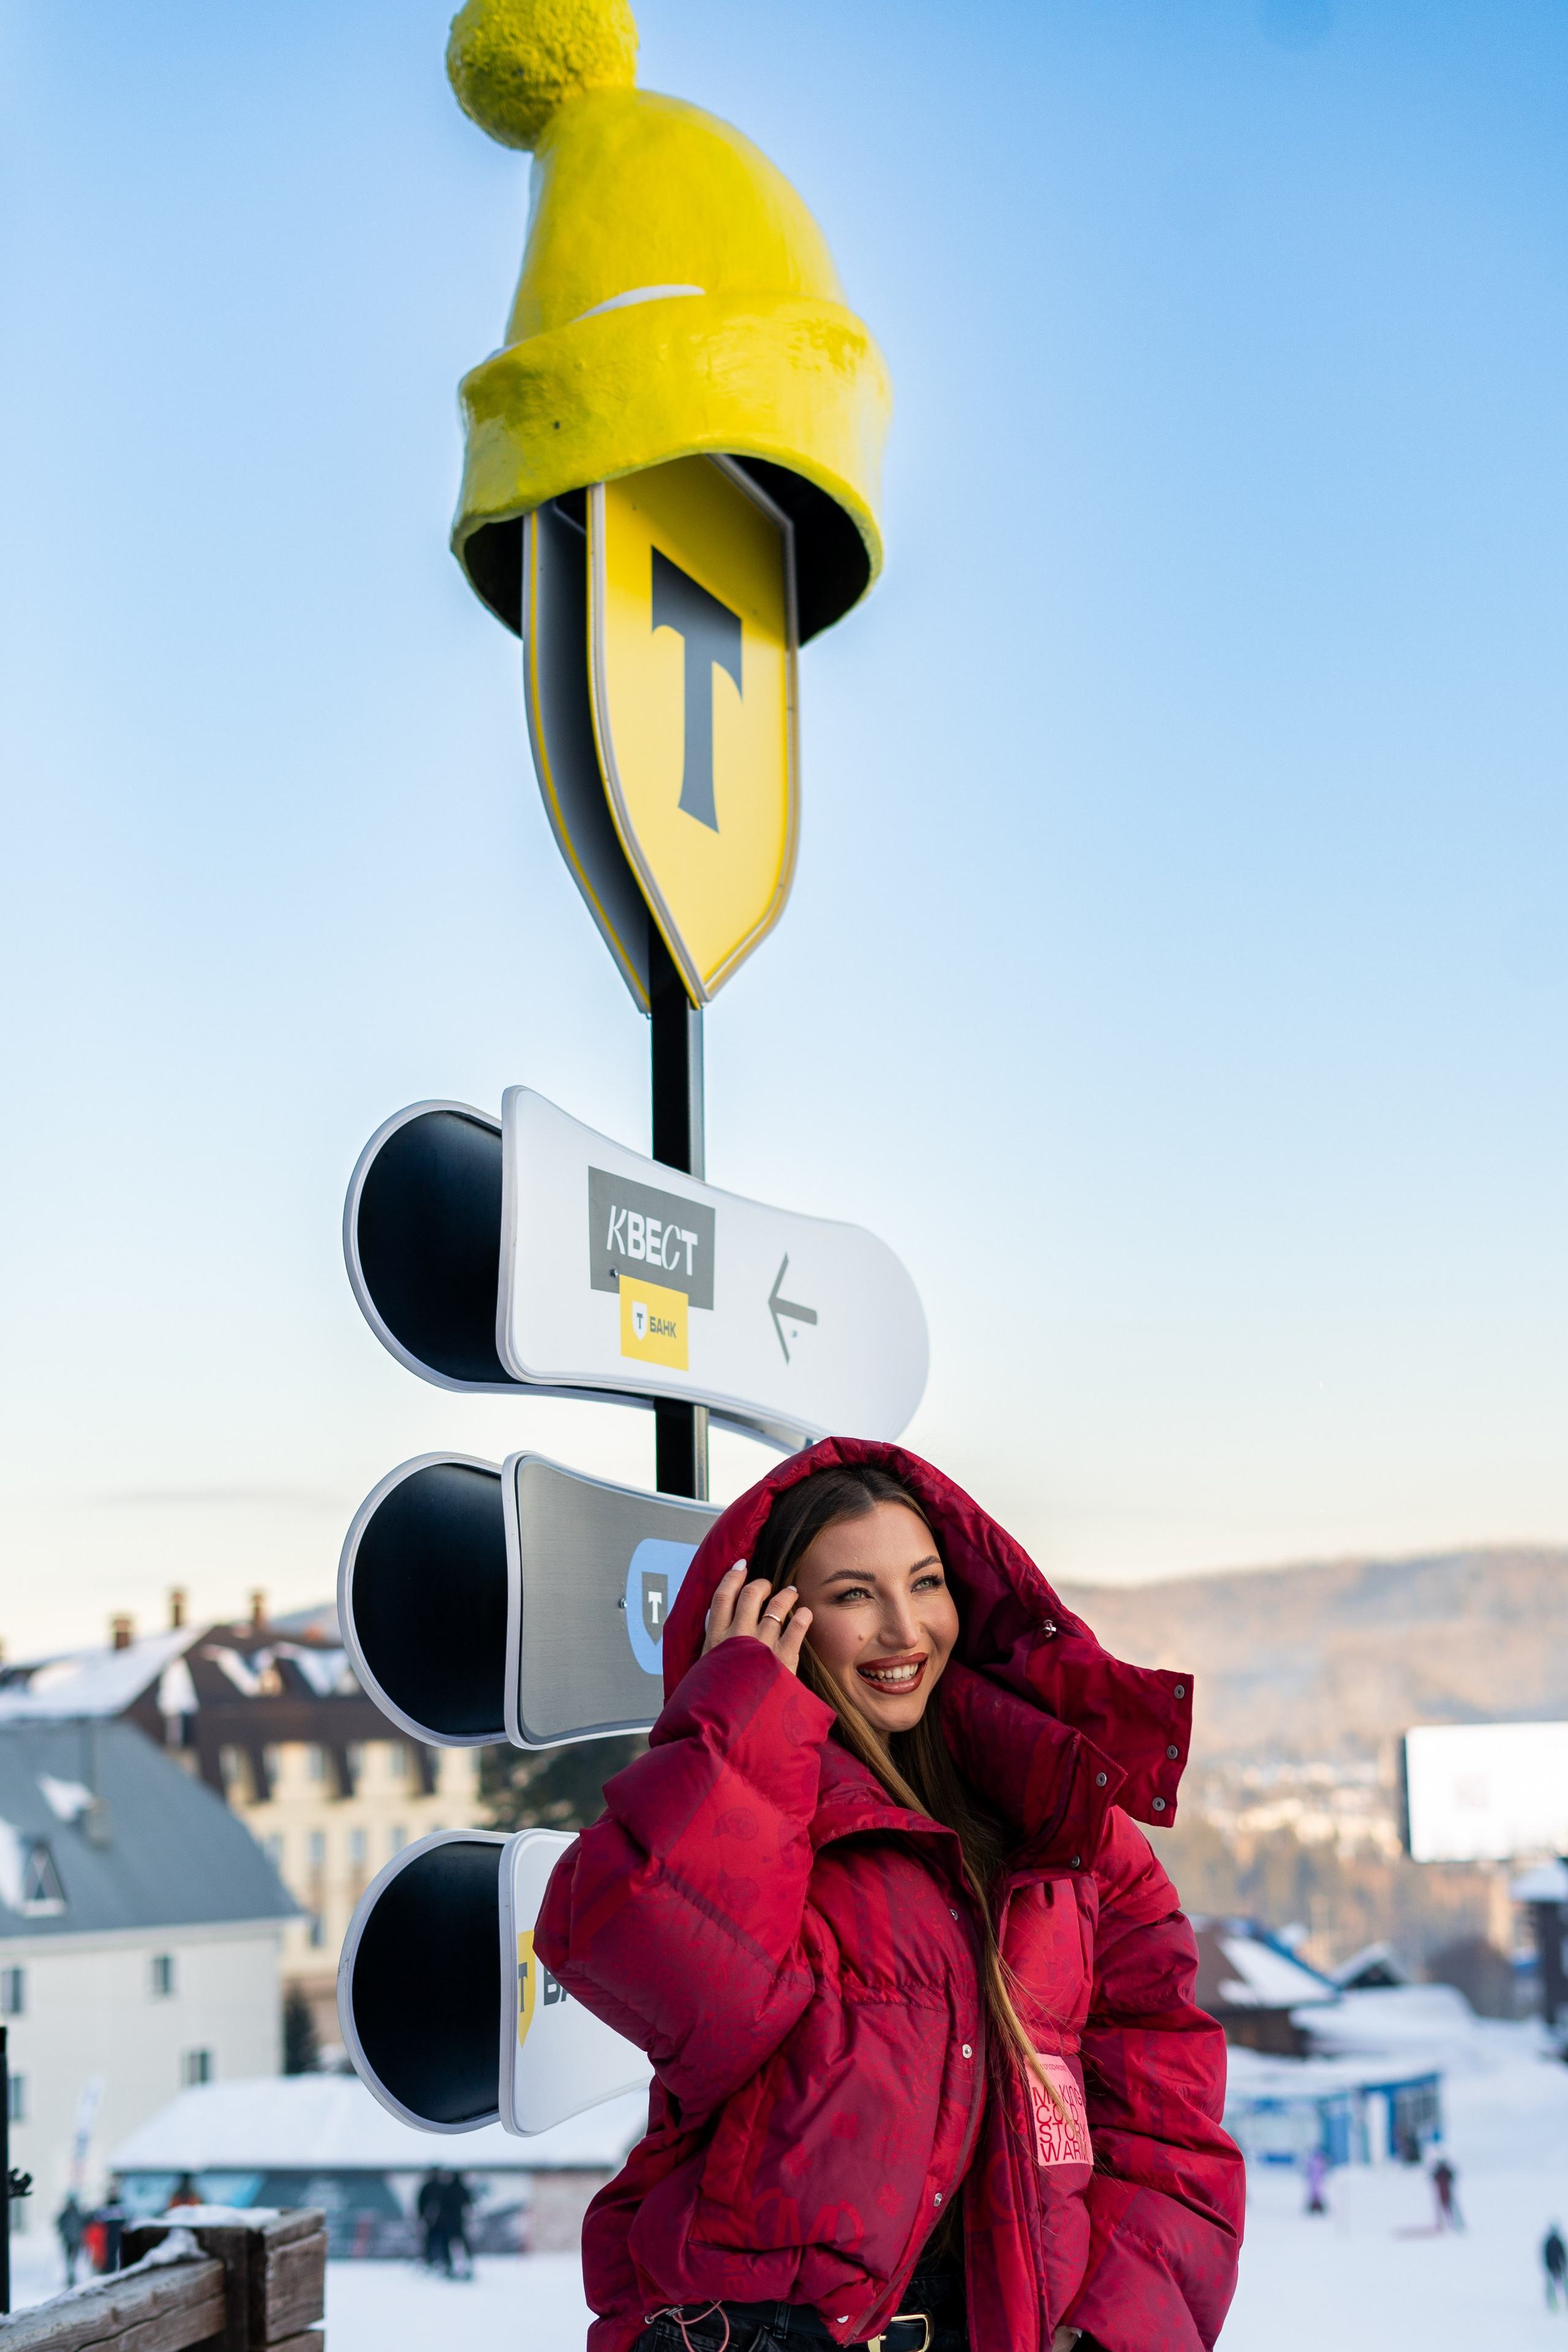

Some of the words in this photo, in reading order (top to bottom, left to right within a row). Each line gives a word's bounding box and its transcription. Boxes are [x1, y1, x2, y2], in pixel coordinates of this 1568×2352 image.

[606, 1205, 698, 1275] КВЕСТ
[649, 1316, 677, 1339] БАНК
[1032, 2084, 1083, 2106] MKING
[1036, 2103, 1079, 2124] COD
[1039, 2122, 1085, 2143] STORY
